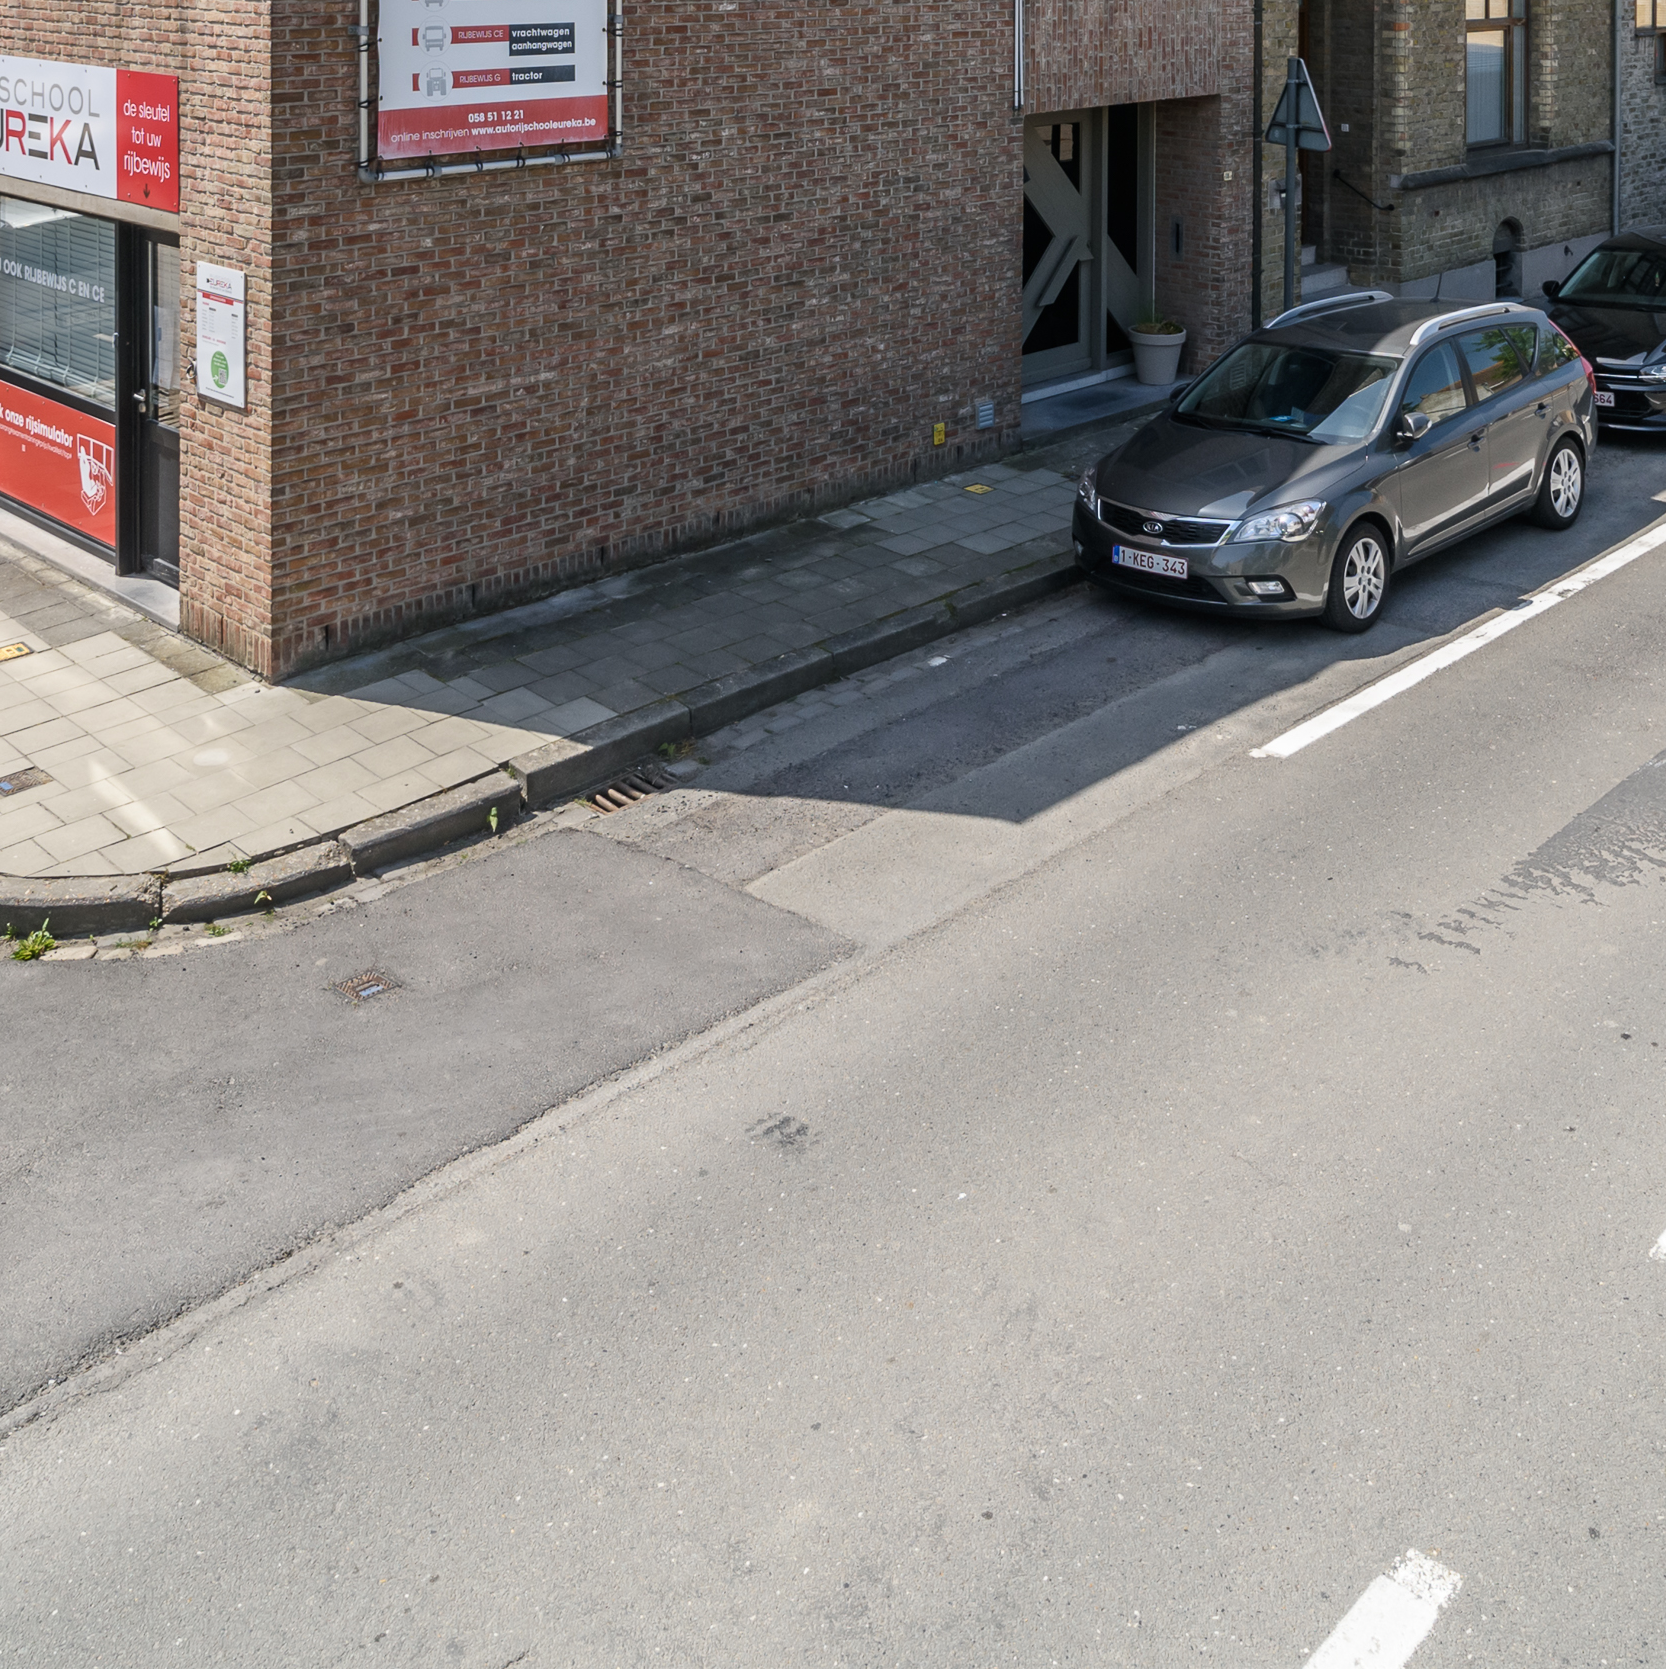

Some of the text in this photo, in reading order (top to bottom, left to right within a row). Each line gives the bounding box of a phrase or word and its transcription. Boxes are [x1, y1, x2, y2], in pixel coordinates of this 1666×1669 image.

[458, 30, 492, 39] RIJBEWIJS
[512, 28, 569, 38] vrachtwagen
[512, 40, 572, 51] aanhangwagen
[460, 75, 493, 83] RIJBEWIJS
[512, 72, 542, 81] tractor
[124, 99, 170, 122] de sleutel
[468, 110, 524, 123] 058 51 12 21
[132, 126, 161, 147] tot uw
[391, 117, 596, 142] online inschrijven www.autorijschooleureka.be
[124, 151, 170, 183] rijbewijs
[4, 259, 22, 278] OOK
[25, 265, 66, 292] RIJBEWIJS
[69, 279, 76, 294] C
[79, 281, 89, 298] EN
[93, 285, 104, 303] CE
[5, 408, 24, 427] onze
[26, 415, 73, 448] rijsimulator
[1121, 550, 1185, 575] 1-KEG-343
